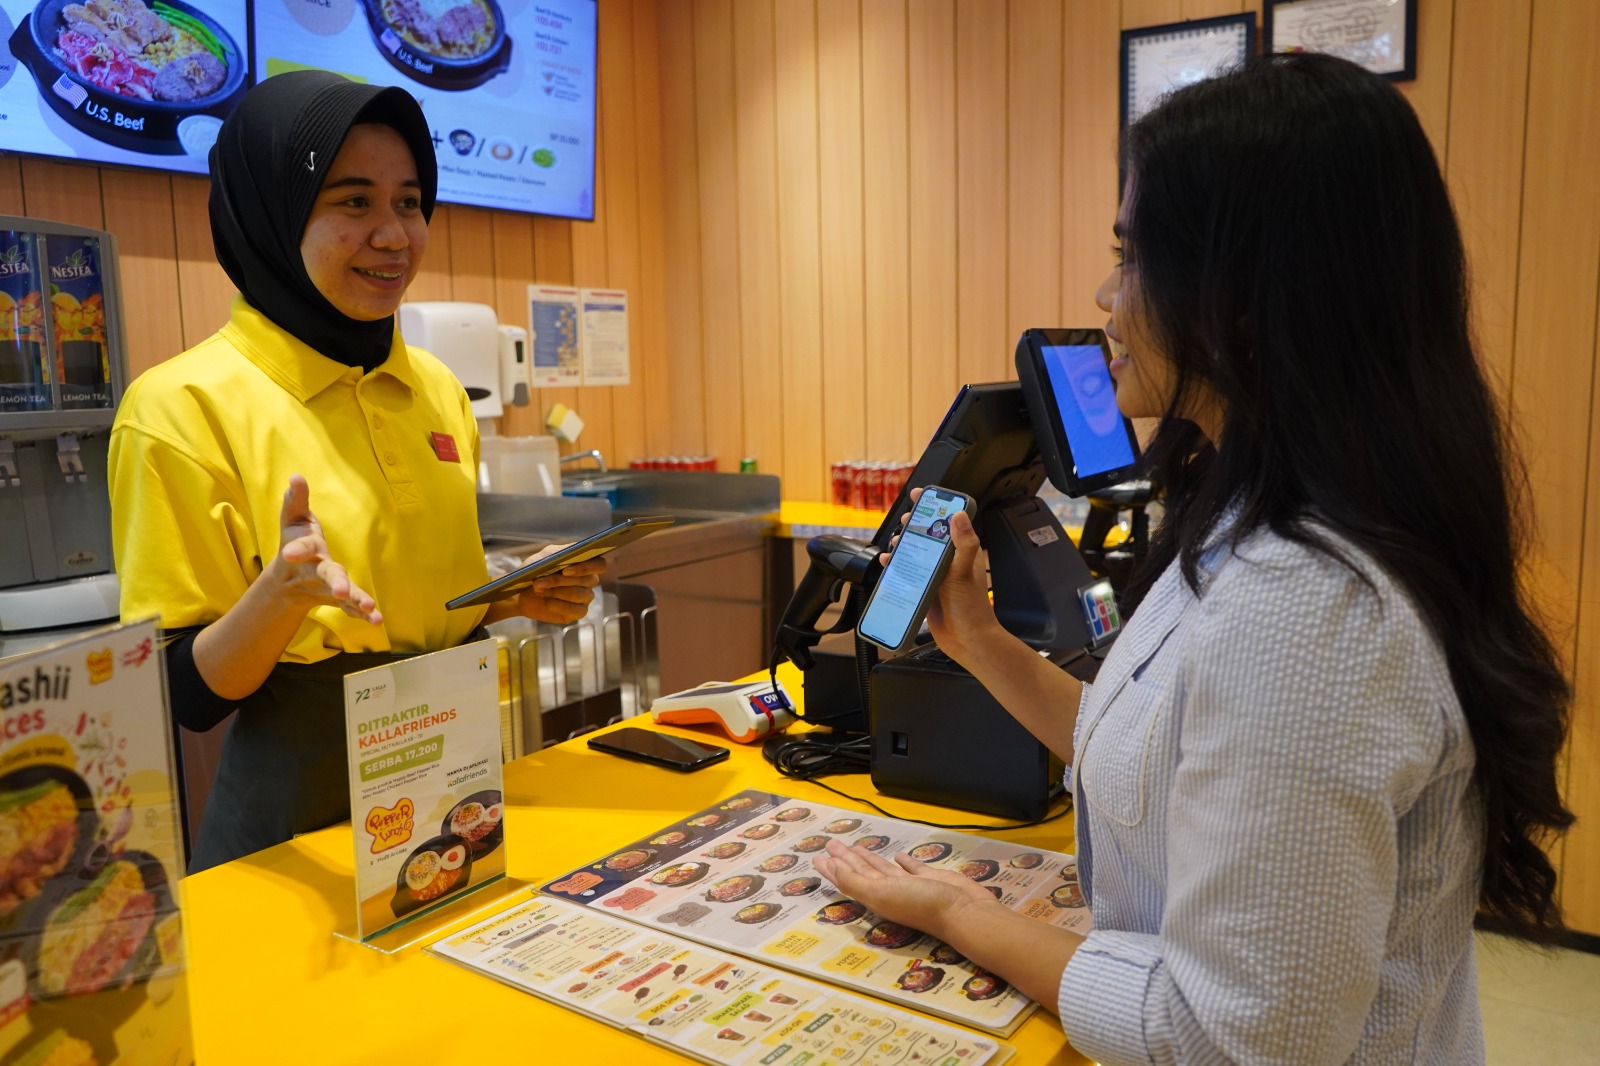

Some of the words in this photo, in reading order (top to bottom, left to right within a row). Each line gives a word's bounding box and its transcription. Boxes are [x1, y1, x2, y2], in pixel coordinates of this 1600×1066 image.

[86, 100, 111, 123] U.S.
[114, 112, 145, 131] Beef
[0, 264, 30, 276] STEA
[52, 266, 92, 278] NESTEA
[0, 396, 28, 404] EMON
[29, 395, 46, 403] TEA
[63, 394, 90, 402] LEMON
[92, 393, 107, 401] TEA
[0, 666, 72, 709] ashii
[358, 704, 429, 734] DITRAKTIR
[358, 708, 457, 749] KALLAFRIENDS
[364, 754, 402, 775] SERBA
[404, 742, 438, 761] 17.200
[469, 758, 488, 769] APLIKASI
[712, 1007, 732, 1020] SHAKE
[732, 994, 752, 1008] SHAKE
[730, 1003, 750, 1016] SALAD
[779, 1019, 802, 1036] ADD-ON
